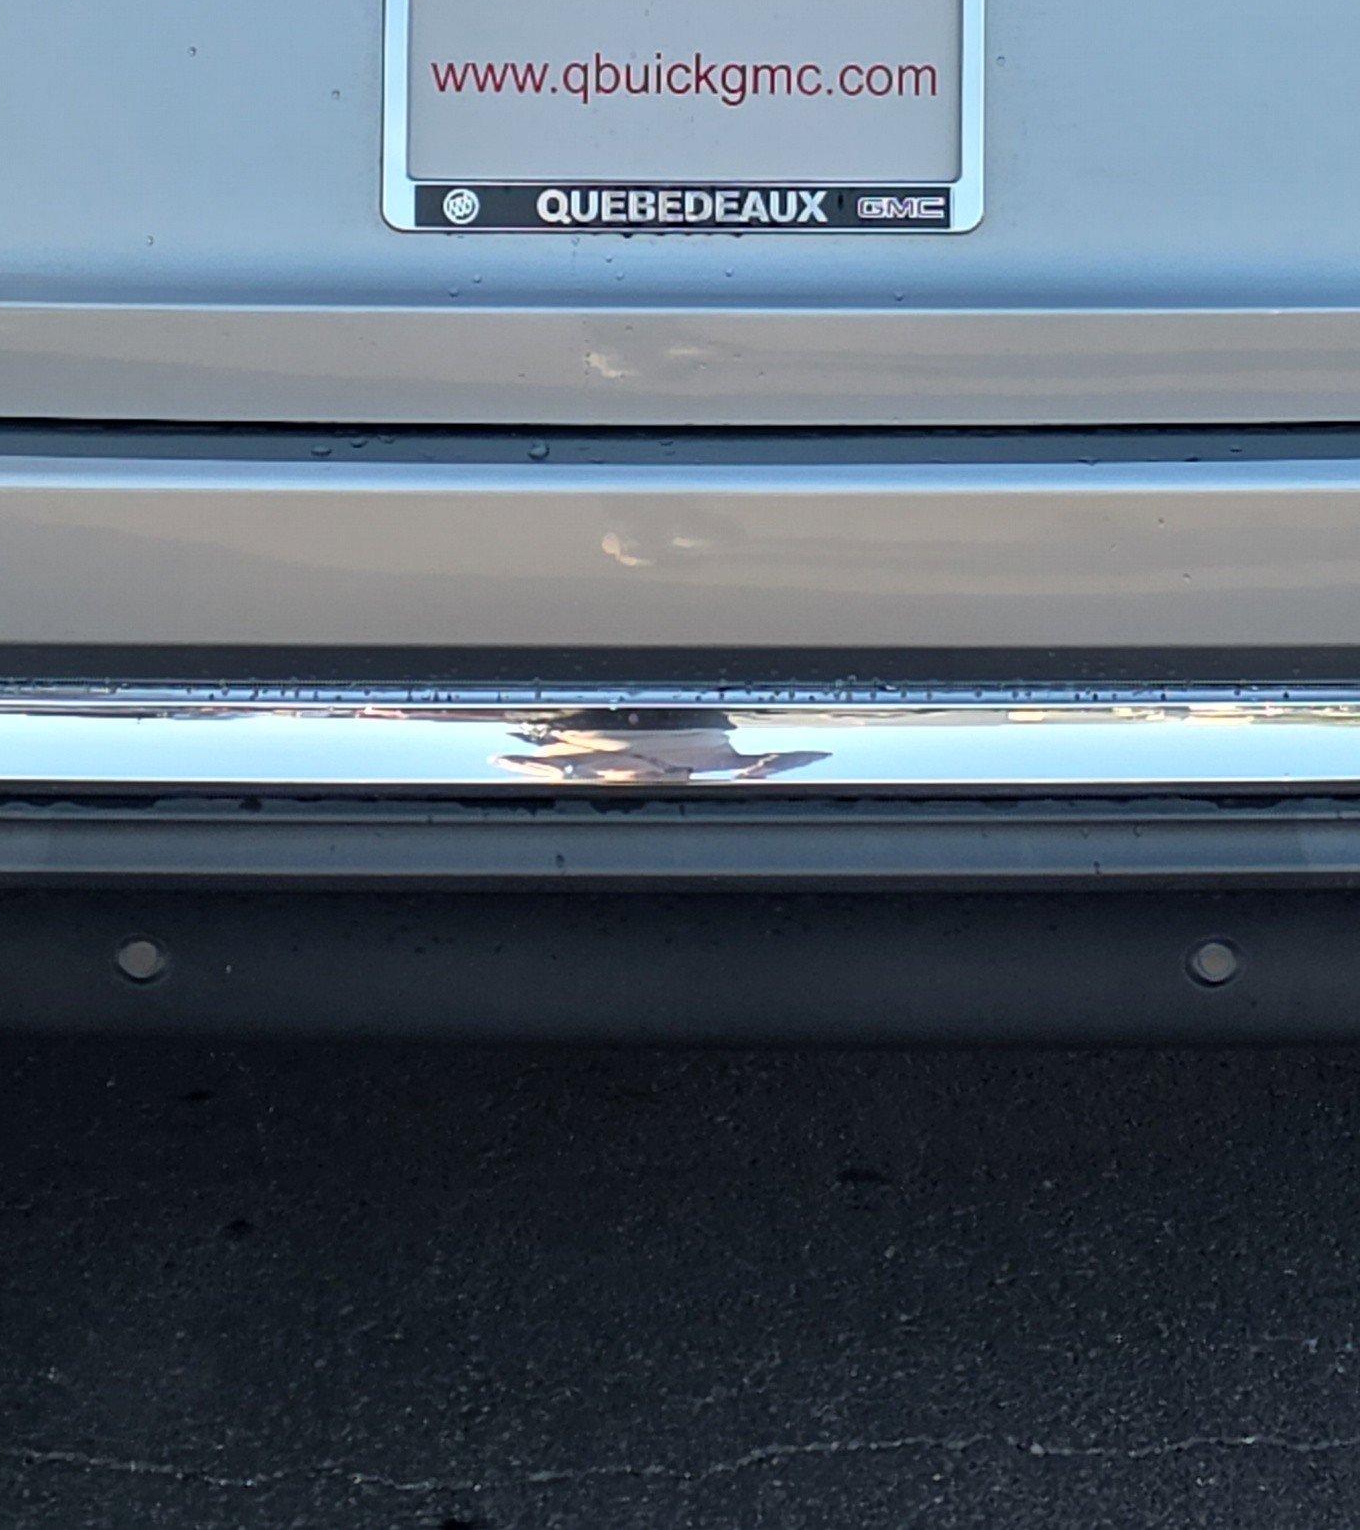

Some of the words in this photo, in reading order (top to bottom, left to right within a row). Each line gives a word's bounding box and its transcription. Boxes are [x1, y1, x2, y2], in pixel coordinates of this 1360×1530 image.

[431, 53, 937, 106] www.qbuickgmc.com
[537, 189, 828, 224] QUEBEDEAUX
[856, 196, 944, 219] GMC
